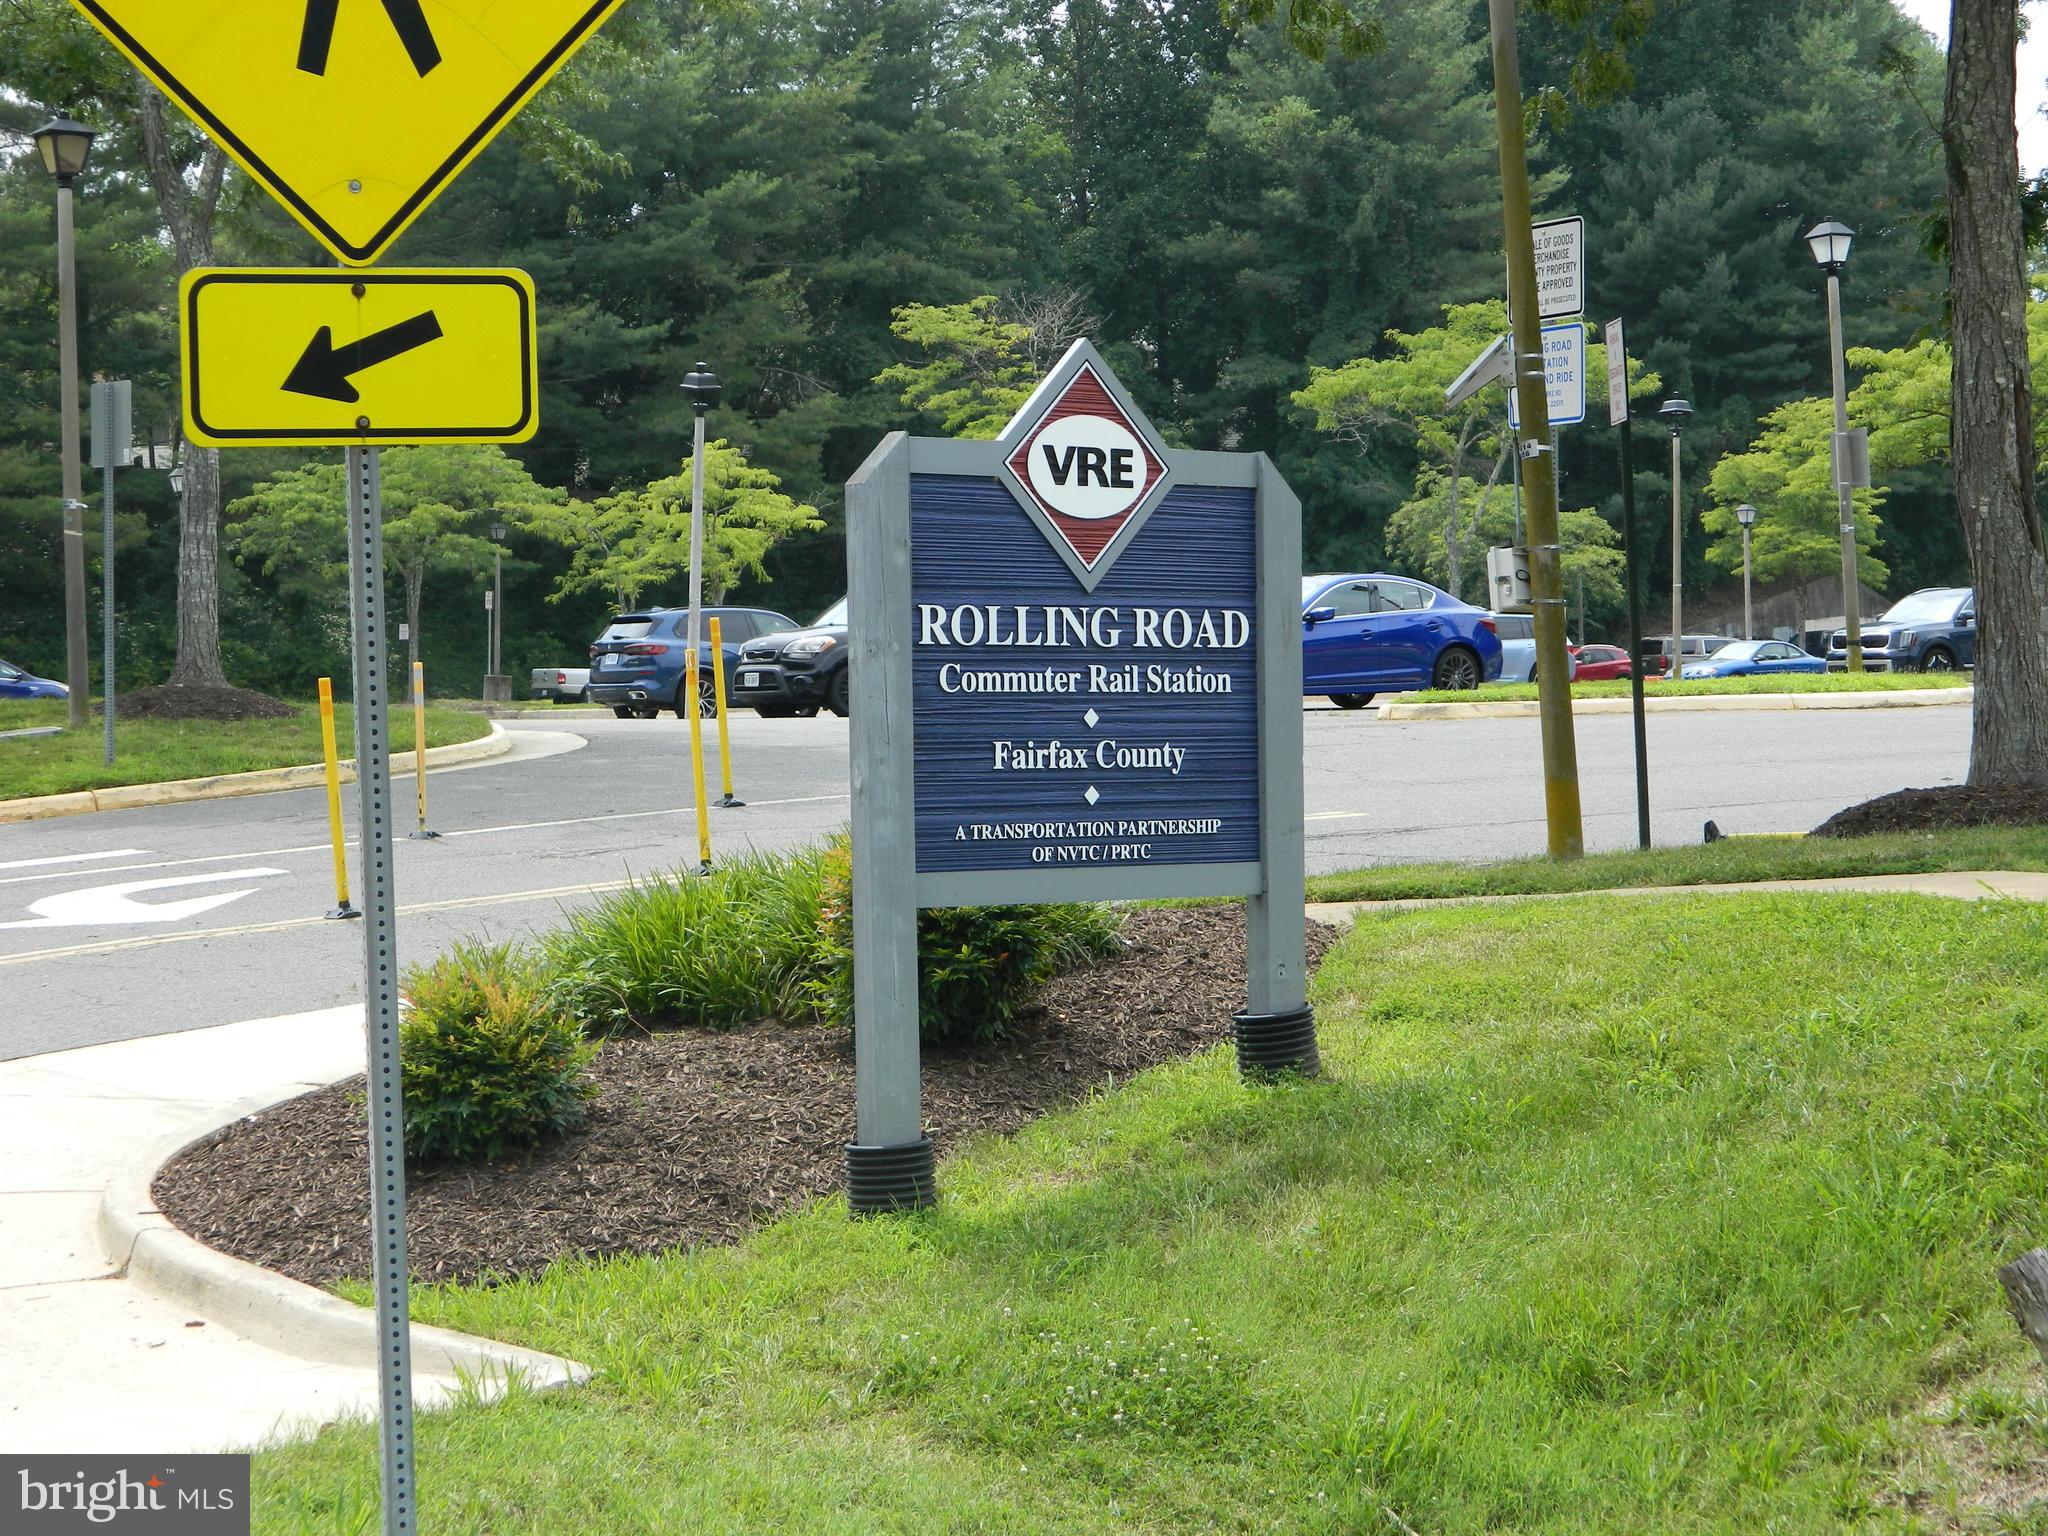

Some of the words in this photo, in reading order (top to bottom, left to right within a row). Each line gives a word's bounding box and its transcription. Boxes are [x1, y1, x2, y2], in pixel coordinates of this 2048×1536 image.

[1543, 236, 1551, 249] OF
[1552, 233, 1574, 247] GOODS
[1534, 247, 1570, 264] ERCHANDISE
[1546, 260, 1577, 276] PROPERTY
[1542, 276, 1574, 292] APPROVED
[1551, 340, 1572, 352] ROAD
[1543, 356, 1569, 369] TATION
[1556, 371, 1574, 383] RIDE
[1042, 444, 1134, 489] VRE
[918, 604, 1123, 648] ROLLING
[1132, 608, 1251, 649] ROAD
[938, 663, 1081, 694] Commuter
[1087, 664, 1140, 693] Rail
[1146, 665, 1233, 694] Station
[992, 740, 1089, 771] Fairfax
[1095, 740, 1187, 775] County
[955, 825, 967, 841] A
[970, 821, 1116, 840] TRANSPORTATION
[1117, 818, 1222, 837] PARTNERSHIP
[1031, 847, 1053, 863] OF
[1056, 845, 1101, 862] NVTC
[1111, 843, 1152, 860] PRTC
